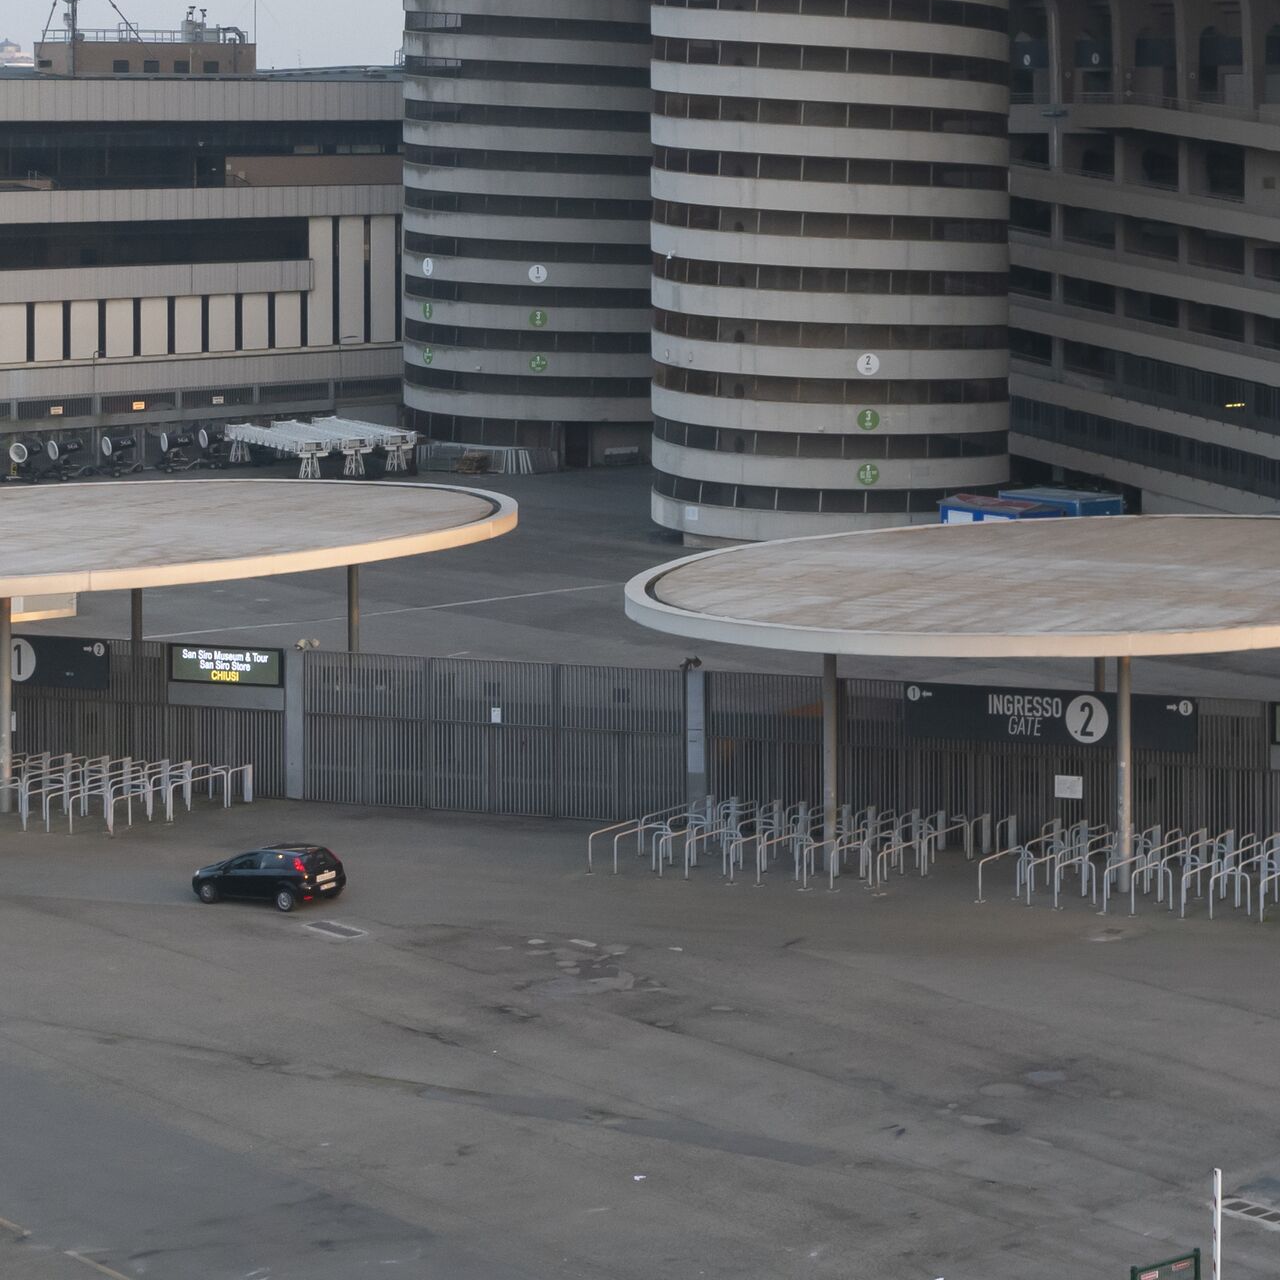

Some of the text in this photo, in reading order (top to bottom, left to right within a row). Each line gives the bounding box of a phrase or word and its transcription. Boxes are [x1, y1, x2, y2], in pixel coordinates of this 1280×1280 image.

[13, 644, 22, 676] 1
[182, 649, 268, 664] San Siro Museum & Tour
[199, 659, 251, 672] San Siro Store
[211, 670, 239, 682] CHIUSI
[988, 694, 1094, 737] INGRESSO 2
[1008, 716, 1042, 736] GATE
